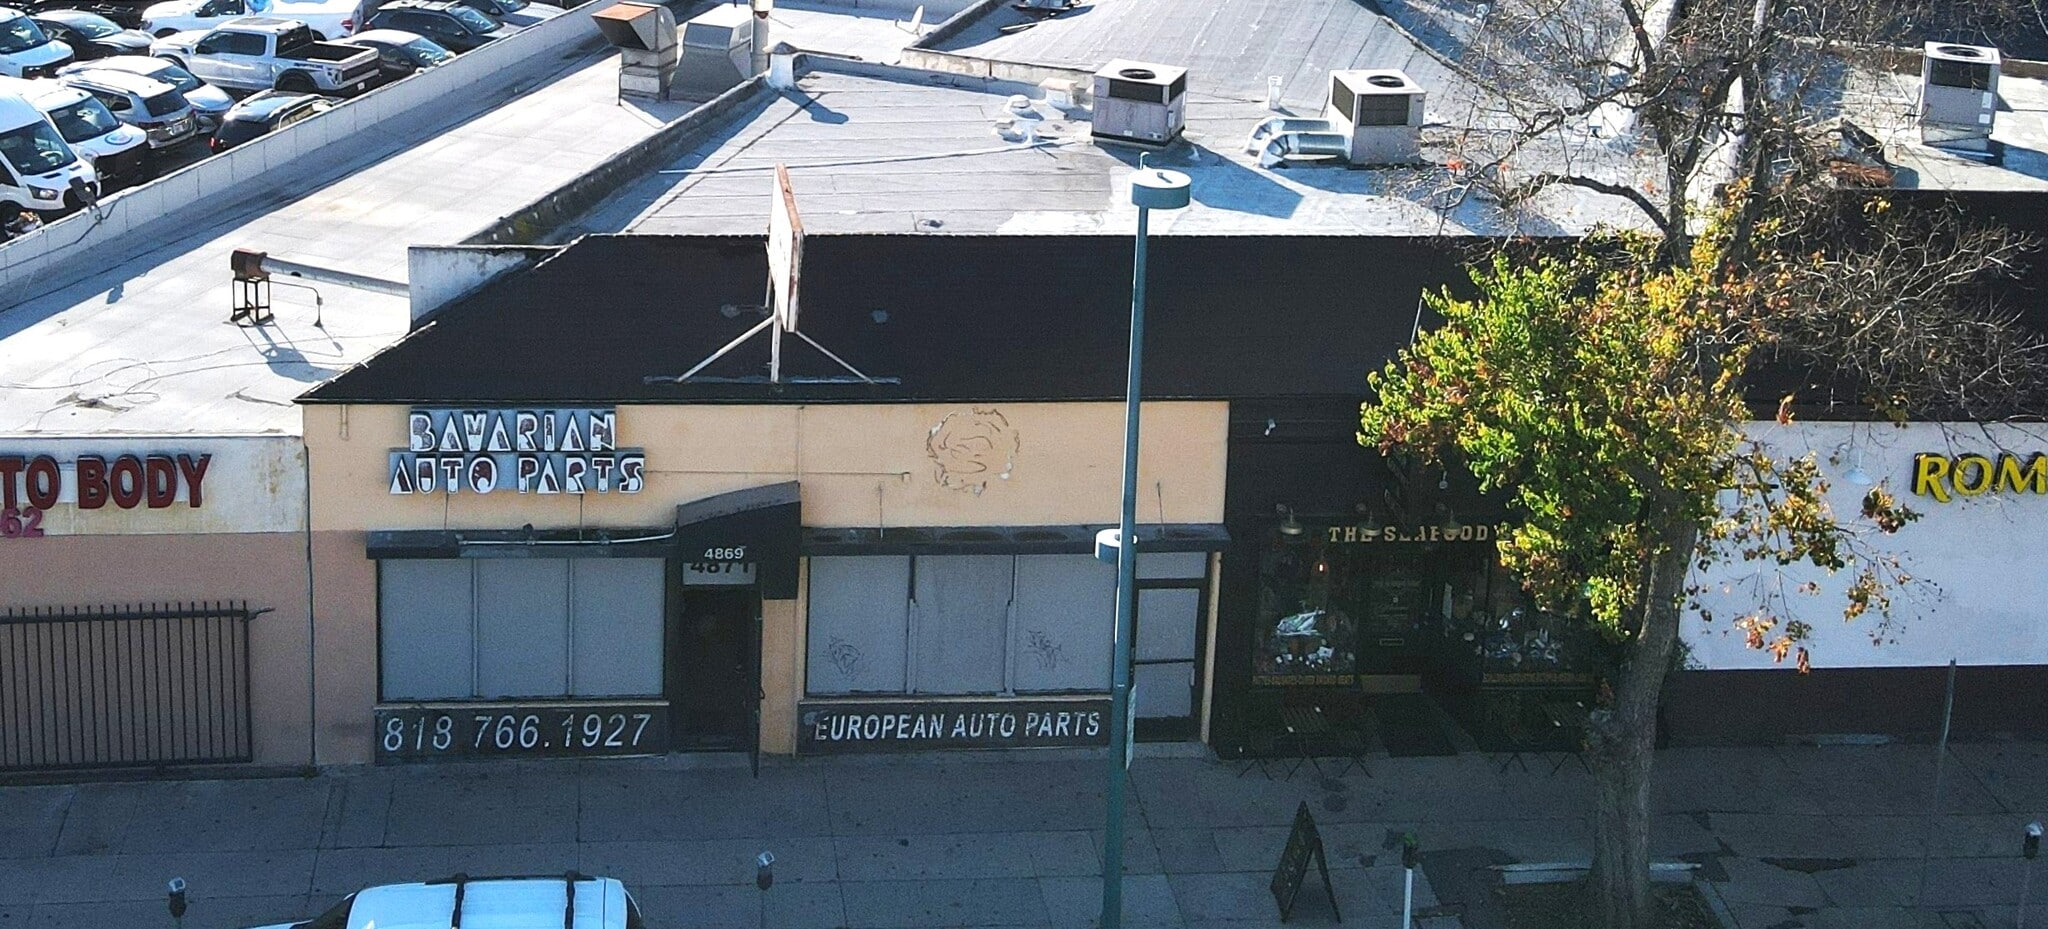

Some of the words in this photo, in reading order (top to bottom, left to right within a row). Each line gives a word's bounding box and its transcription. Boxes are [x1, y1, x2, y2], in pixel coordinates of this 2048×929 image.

[409, 411, 617, 451] BAVARIAN
[0, 455, 61, 510] TO
[77, 453, 212, 509] BODY
[389, 455, 499, 494] AUTO
[518, 455, 646, 494] PARTS
[1911, 451, 2048, 503] ROM
[0, 506, 44, 538] 62
[704, 548, 744, 559] 4869
[383, 715, 453, 751] 818
[473, 713, 651, 749] 766.1927
[814, 713, 945, 741] EUROPEAN
[950, 712, 1017, 738] AUTO
[1024, 711, 1101, 737] PARTS
